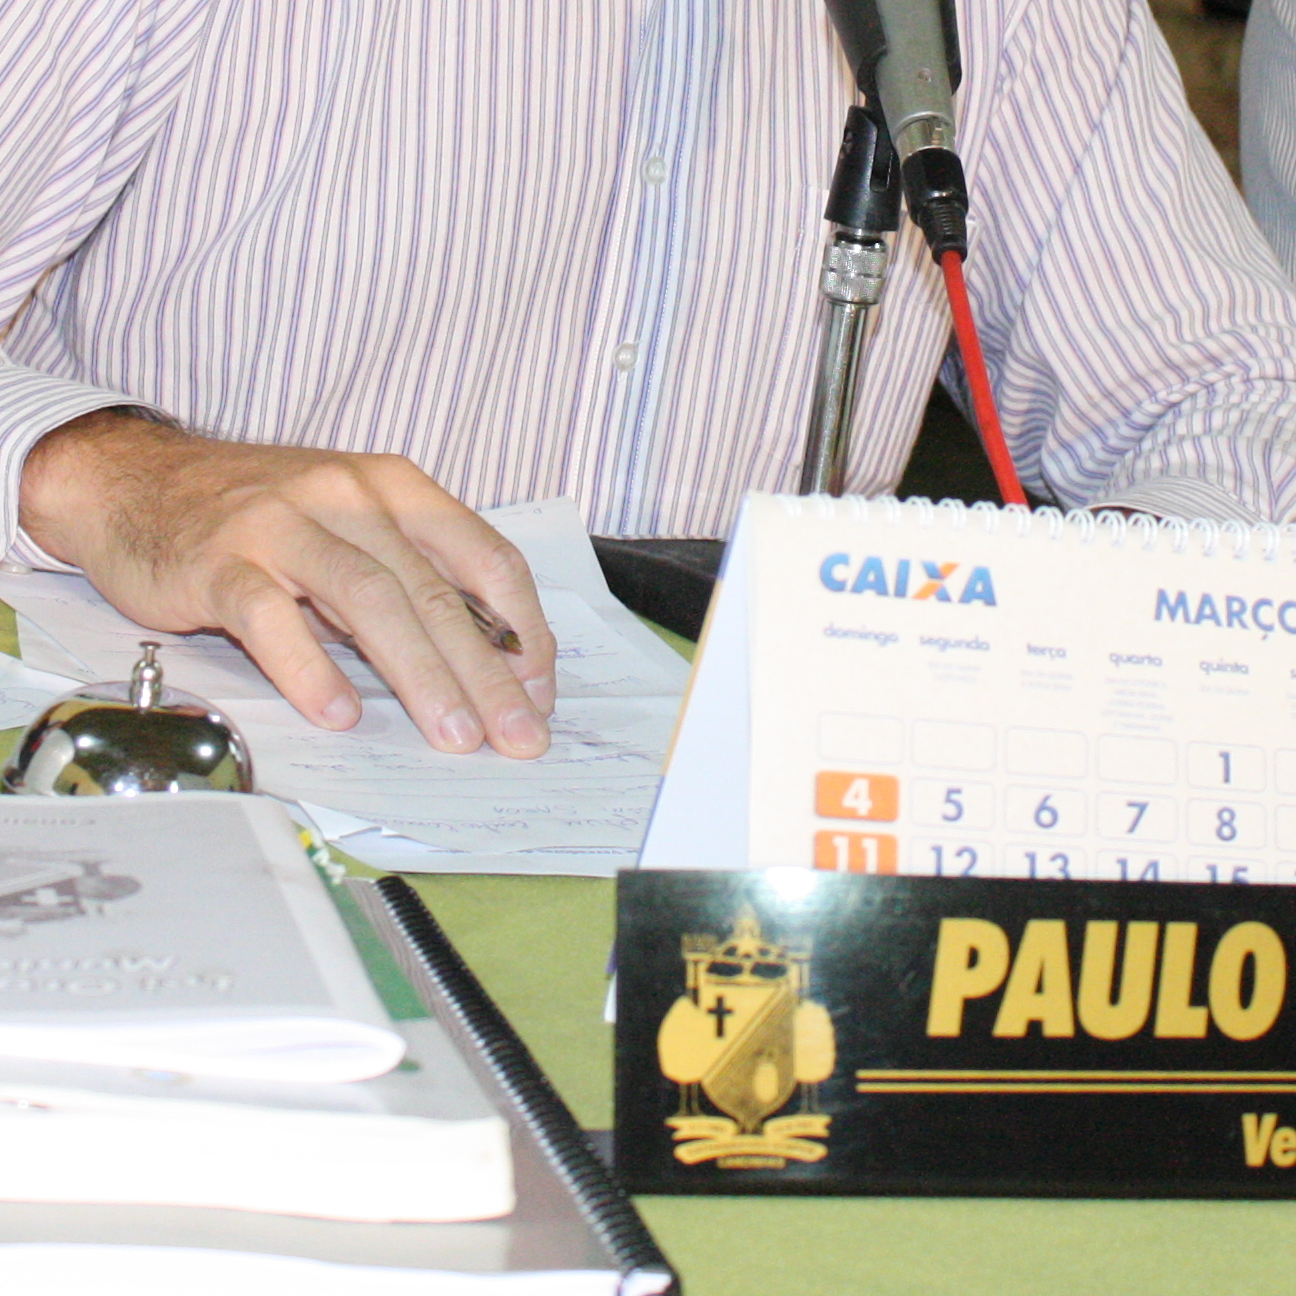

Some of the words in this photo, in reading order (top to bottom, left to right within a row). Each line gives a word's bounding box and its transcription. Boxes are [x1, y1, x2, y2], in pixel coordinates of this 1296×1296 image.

[819, 552, 998, 607] CAIXA
[823, 622, 899, 646] domingo
[919, 635, 990, 652] segunda
[1026, 642, 1067, 660] terça
[1109, 653, 1163, 669] quarta
[1199, 658, 1250, 676] quinta
[1218, 751, 1231, 784] 1
[841, 777, 873, 817] 4
[942, 787, 964, 822] 5
[1034, 794, 1059, 829] 6
[1126, 801, 1150, 835] 7
[1215, 806, 1238, 842] 8
[832, 835, 879, 873] 11
[931, 845, 978, 877] 12
[1025, 851, 1071, 880] 13
[925, 918, 1287, 1040] PAULO
